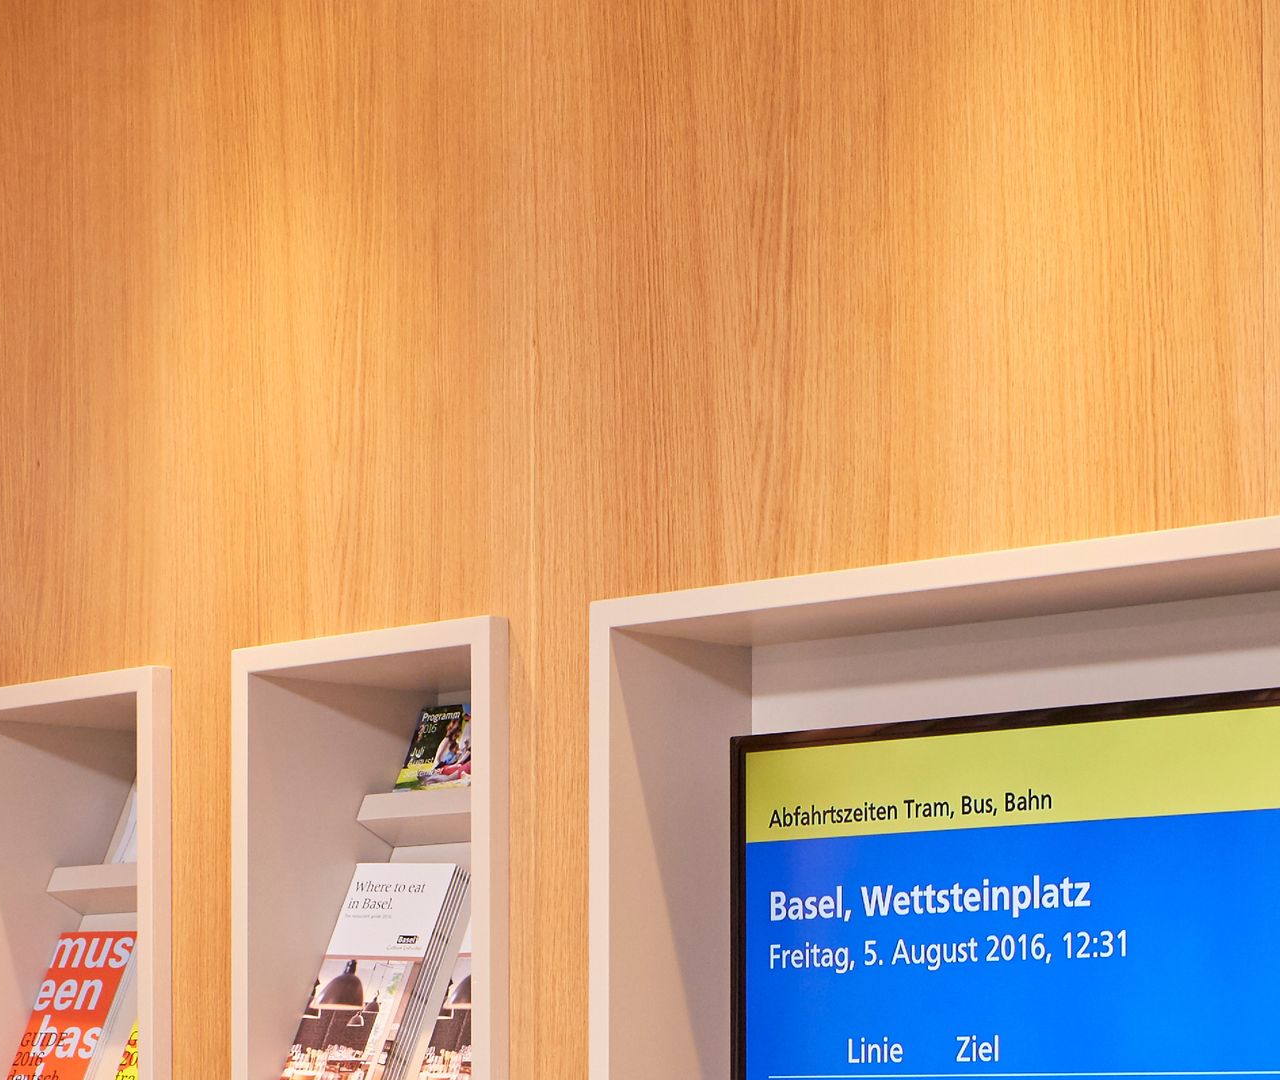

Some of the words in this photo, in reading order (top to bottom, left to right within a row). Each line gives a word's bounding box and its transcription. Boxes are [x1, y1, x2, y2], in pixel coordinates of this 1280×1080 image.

[422, 711, 461, 723] Programm
[769, 802, 898, 829] Abfahrtszeiten
[903, 799, 955, 820] Tram,
[961, 795, 998, 817] Bus,
[1005, 789, 1052, 812] Bahn
[355, 881, 392, 893] Where
[394, 883, 406, 893] to
[408, 883, 426, 893] eat
[770, 886, 852, 922] Basel,
[861, 874, 1091, 918] Wettsteinplatz
[347, 898, 359, 909] in
[361, 897, 393, 910] Basel.
[49, 937, 135, 969] mus
[770, 941, 855, 974] Freitag,
[864, 940, 884, 966] 5.
[892, 937, 978, 971] August
[986, 933, 1052, 964] 2016,
[1063, 929, 1127, 959] 12:31
[33, 978, 103, 1011] een
[20, 1031, 68, 1047] GUIDE
[30, 1014, 103, 1059] bas
[848, 1036, 904, 1064] Linie
[956, 1034, 999, 1062] Ziel
[12, 1051, 45, 1066] 2016
